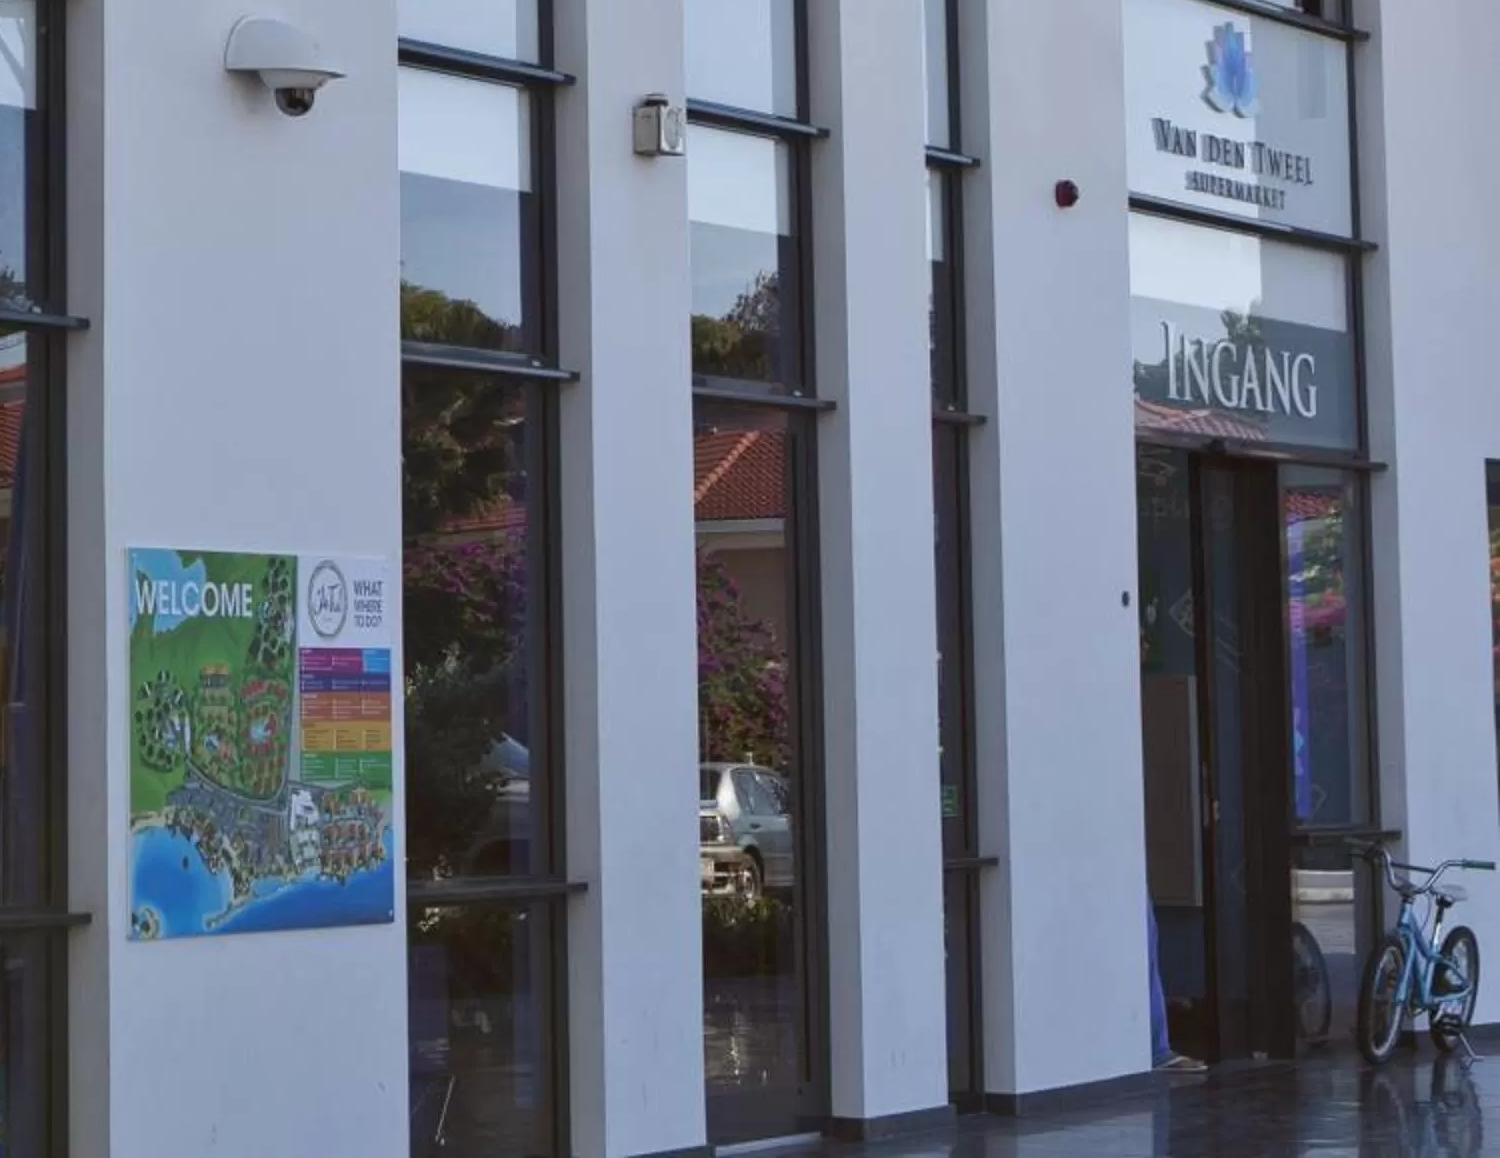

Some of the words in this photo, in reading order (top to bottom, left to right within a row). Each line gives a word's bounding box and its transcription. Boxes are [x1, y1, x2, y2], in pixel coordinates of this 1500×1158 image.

[1152, 117, 1197, 158] VAN
[1201, 134, 1245, 169] DEN
[1249, 141, 1314, 186] TWEEL
[1185, 170, 1286, 211] SUPERMARKET
[1160, 319, 1317, 419] INGANG
[135, 579, 254, 617] WELCOME
[353, 580, 384, 597] WHAT
